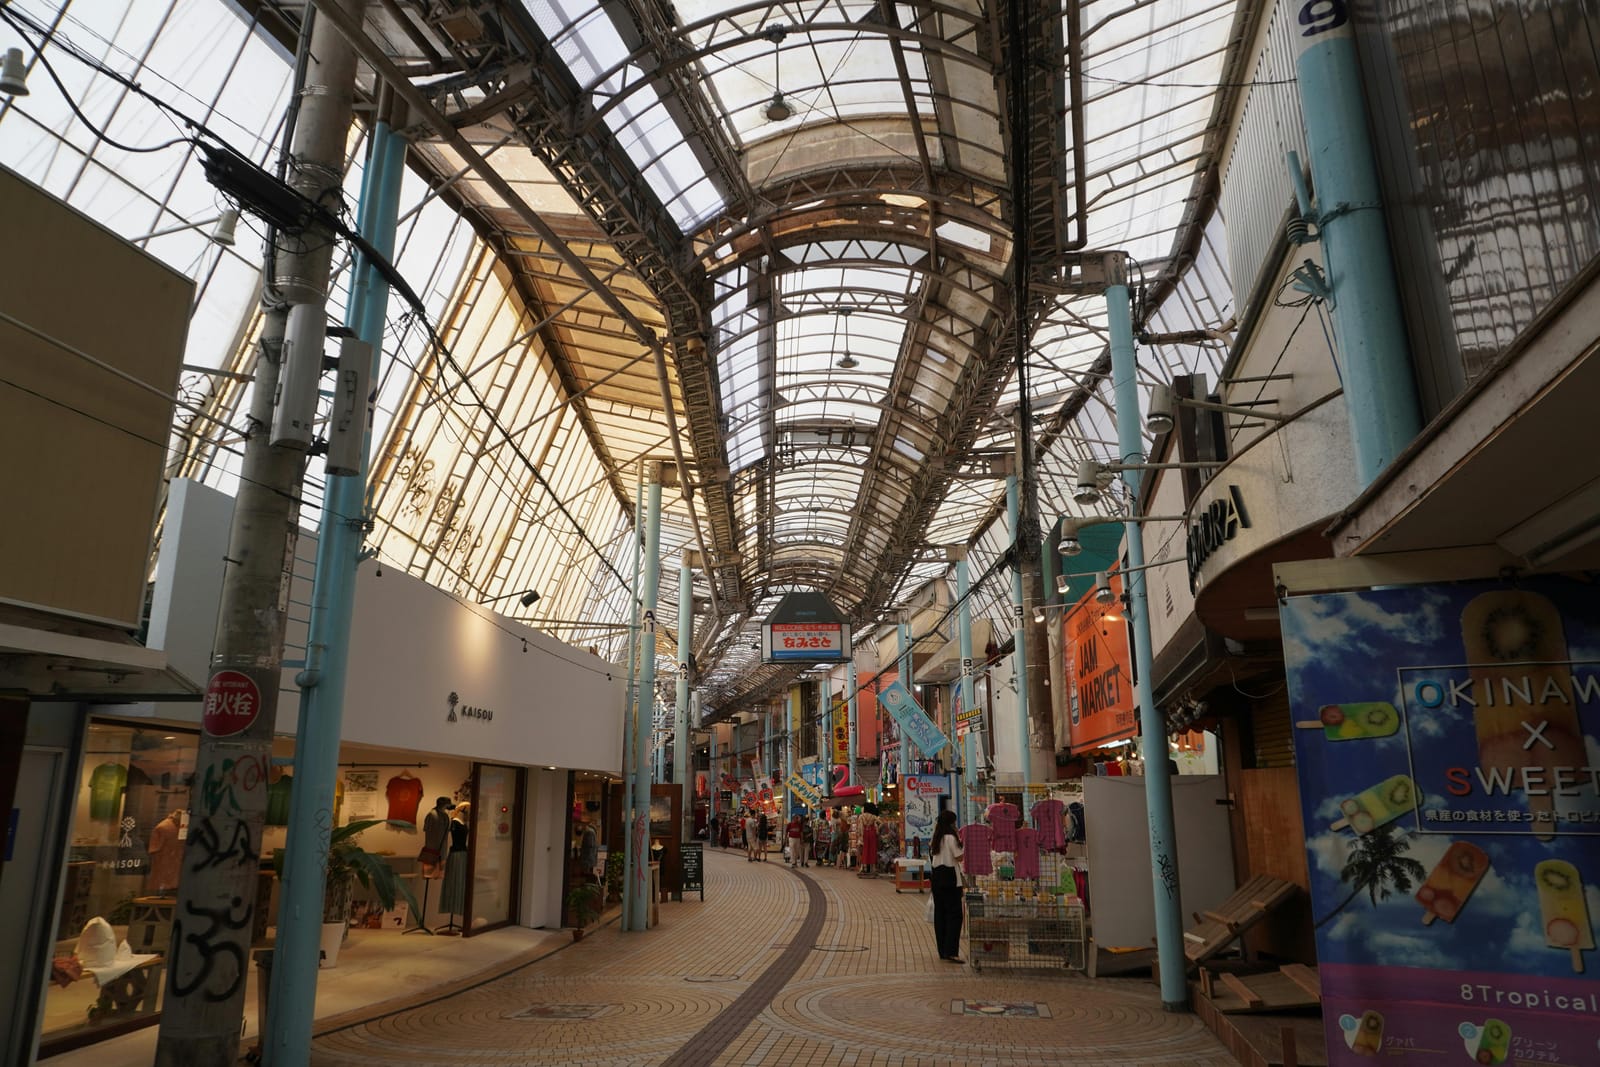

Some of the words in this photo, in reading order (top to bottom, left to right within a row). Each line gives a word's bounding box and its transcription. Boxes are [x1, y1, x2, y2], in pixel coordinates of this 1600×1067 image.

[643, 610, 655, 620] A
[1014, 606, 1023, 616] B
[643, 622, 654, 632] 11
[783, 637, 832, 648] なみさと
[1079, 634, 1098, 678] JAM
[963, 659, 972, 667] B
[679, 672, 688, 680] 12
[1080, 664, 1120, 719] MARKET
[205, 691, 254, 715] 消火栓
[462, 705, 493, 721] KAISOU
[103, 859, 141, 869] KAISOU
[1512, 1036, 1558, 1050] グリーン
[1514, 1048, 1560, 1062] カクテル
